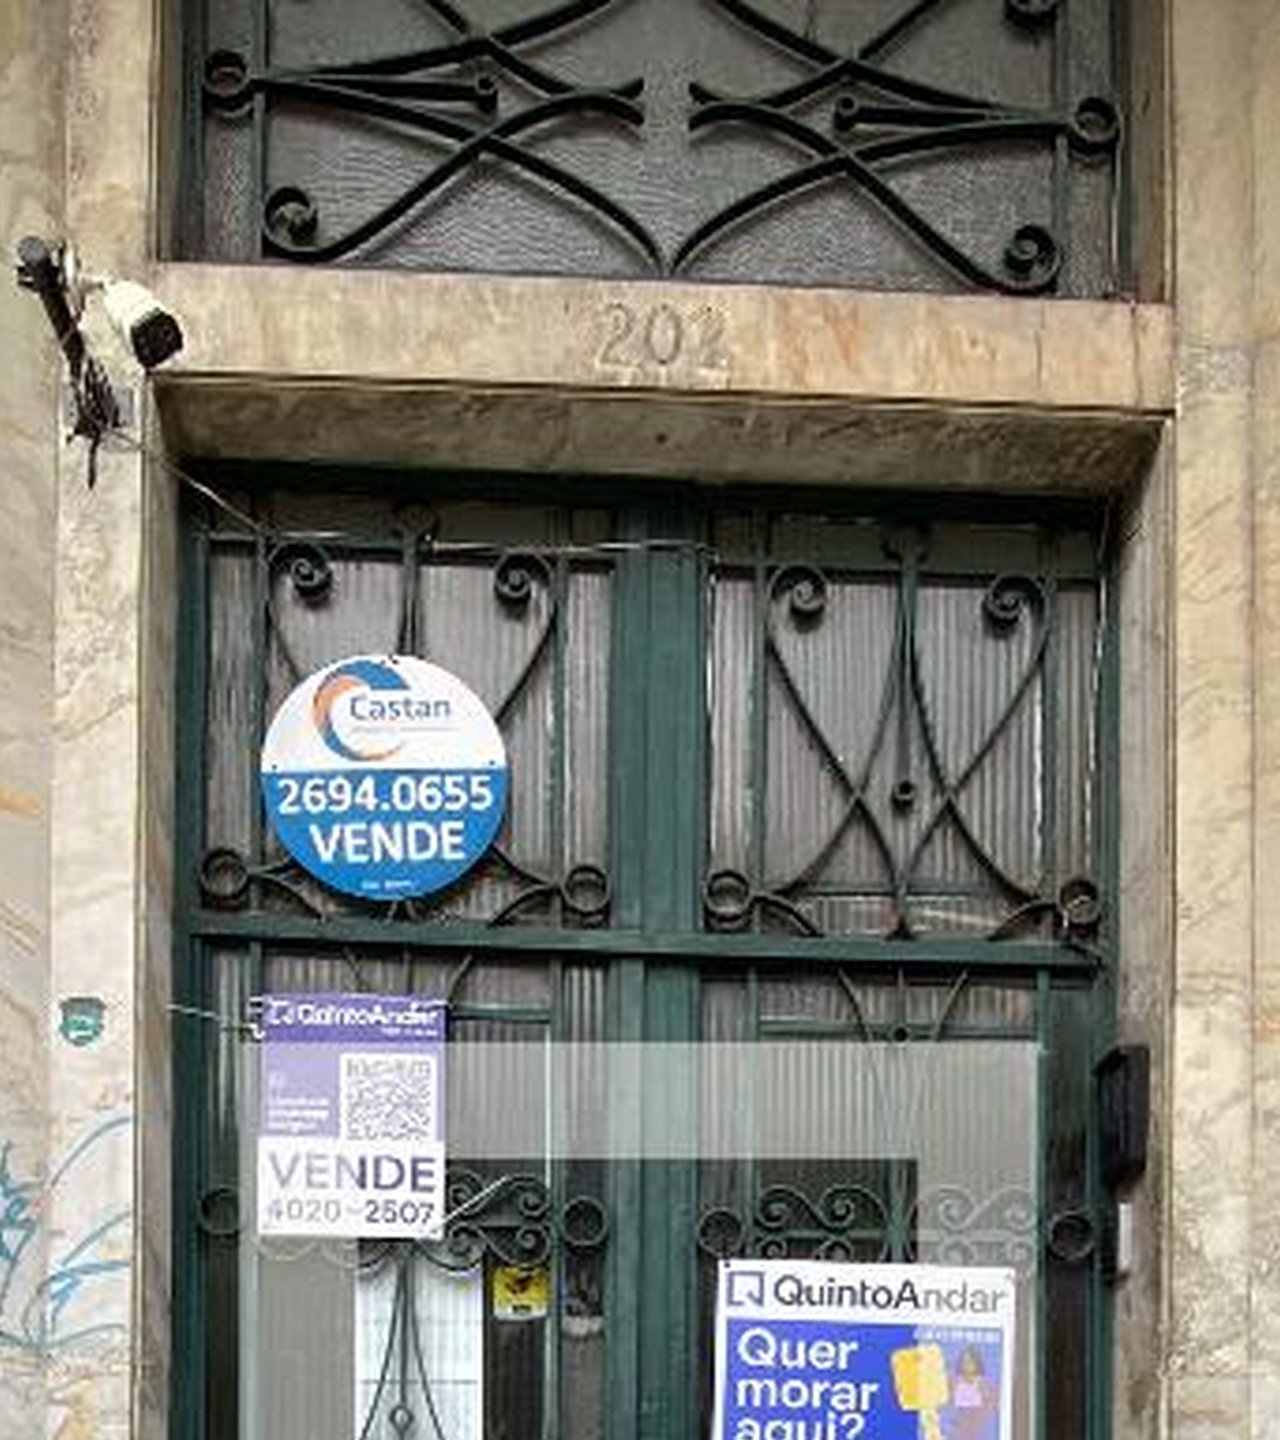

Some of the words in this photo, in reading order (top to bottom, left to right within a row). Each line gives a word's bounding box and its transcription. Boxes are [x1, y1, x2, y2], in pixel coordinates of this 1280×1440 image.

[350, 694, 451, 720] Castan
[277, 774, 493, 814] 2694.0655
[310, 820, 466, 863] VENDE
[269, 1153, 436, 1194] VENDE
[773, 1275, 1005, 1313] QuintoAndar
[738, 1328, 859, 1369] Quer
[735, 1378, 880, 1412] morar
